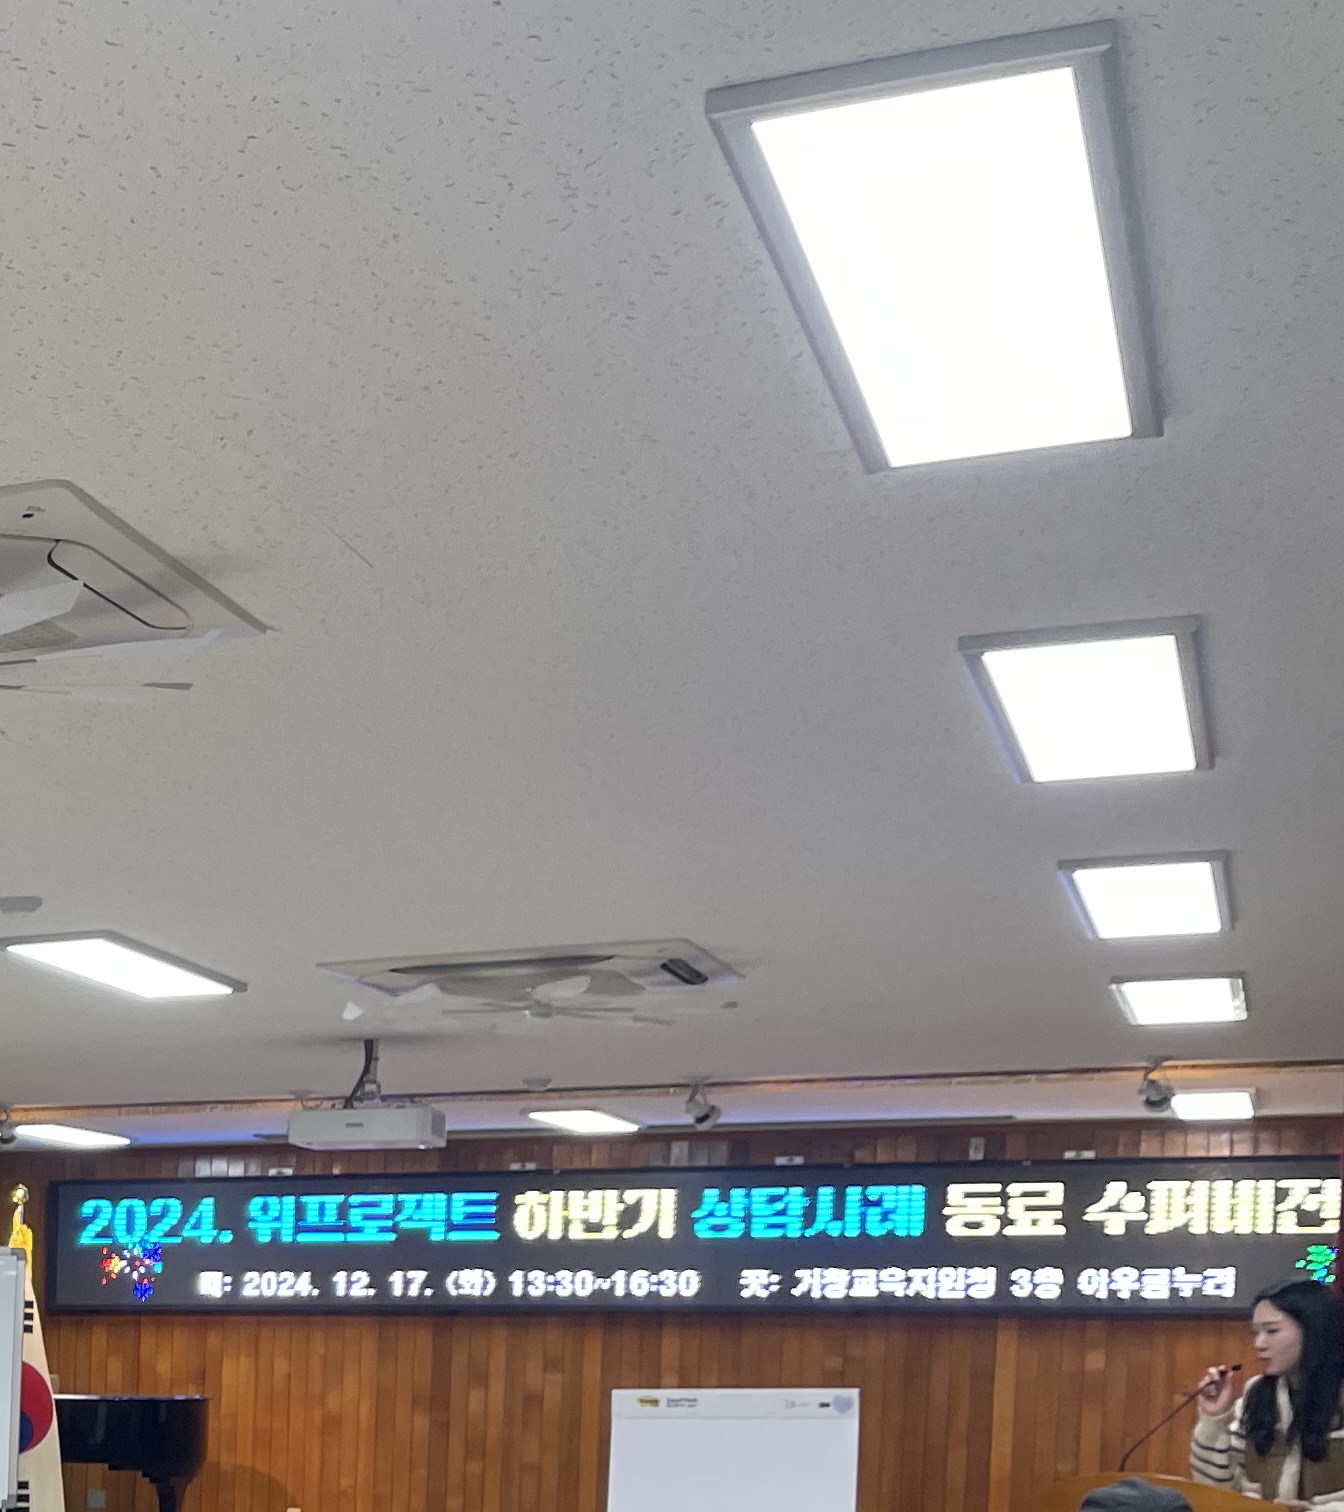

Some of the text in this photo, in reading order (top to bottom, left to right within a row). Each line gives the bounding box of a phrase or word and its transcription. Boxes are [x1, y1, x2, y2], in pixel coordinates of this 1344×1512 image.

[75, 1195, 234, 1245] 2024.
[247, 1190, 501, 1243] 위프로젝트
[512, 1187, 679, 1241] 하반기
[690, 1184, 927, 1240] 상담사례
[943, 1182, 1066, 1237] 동료
[242, 1269, 320, 1298] 2024.
[332, 1269, 377, 1298] 12.
[388, 1269, 434, 1297] 17.
[508, 1268, 702, 1298] 13:30~16:30
